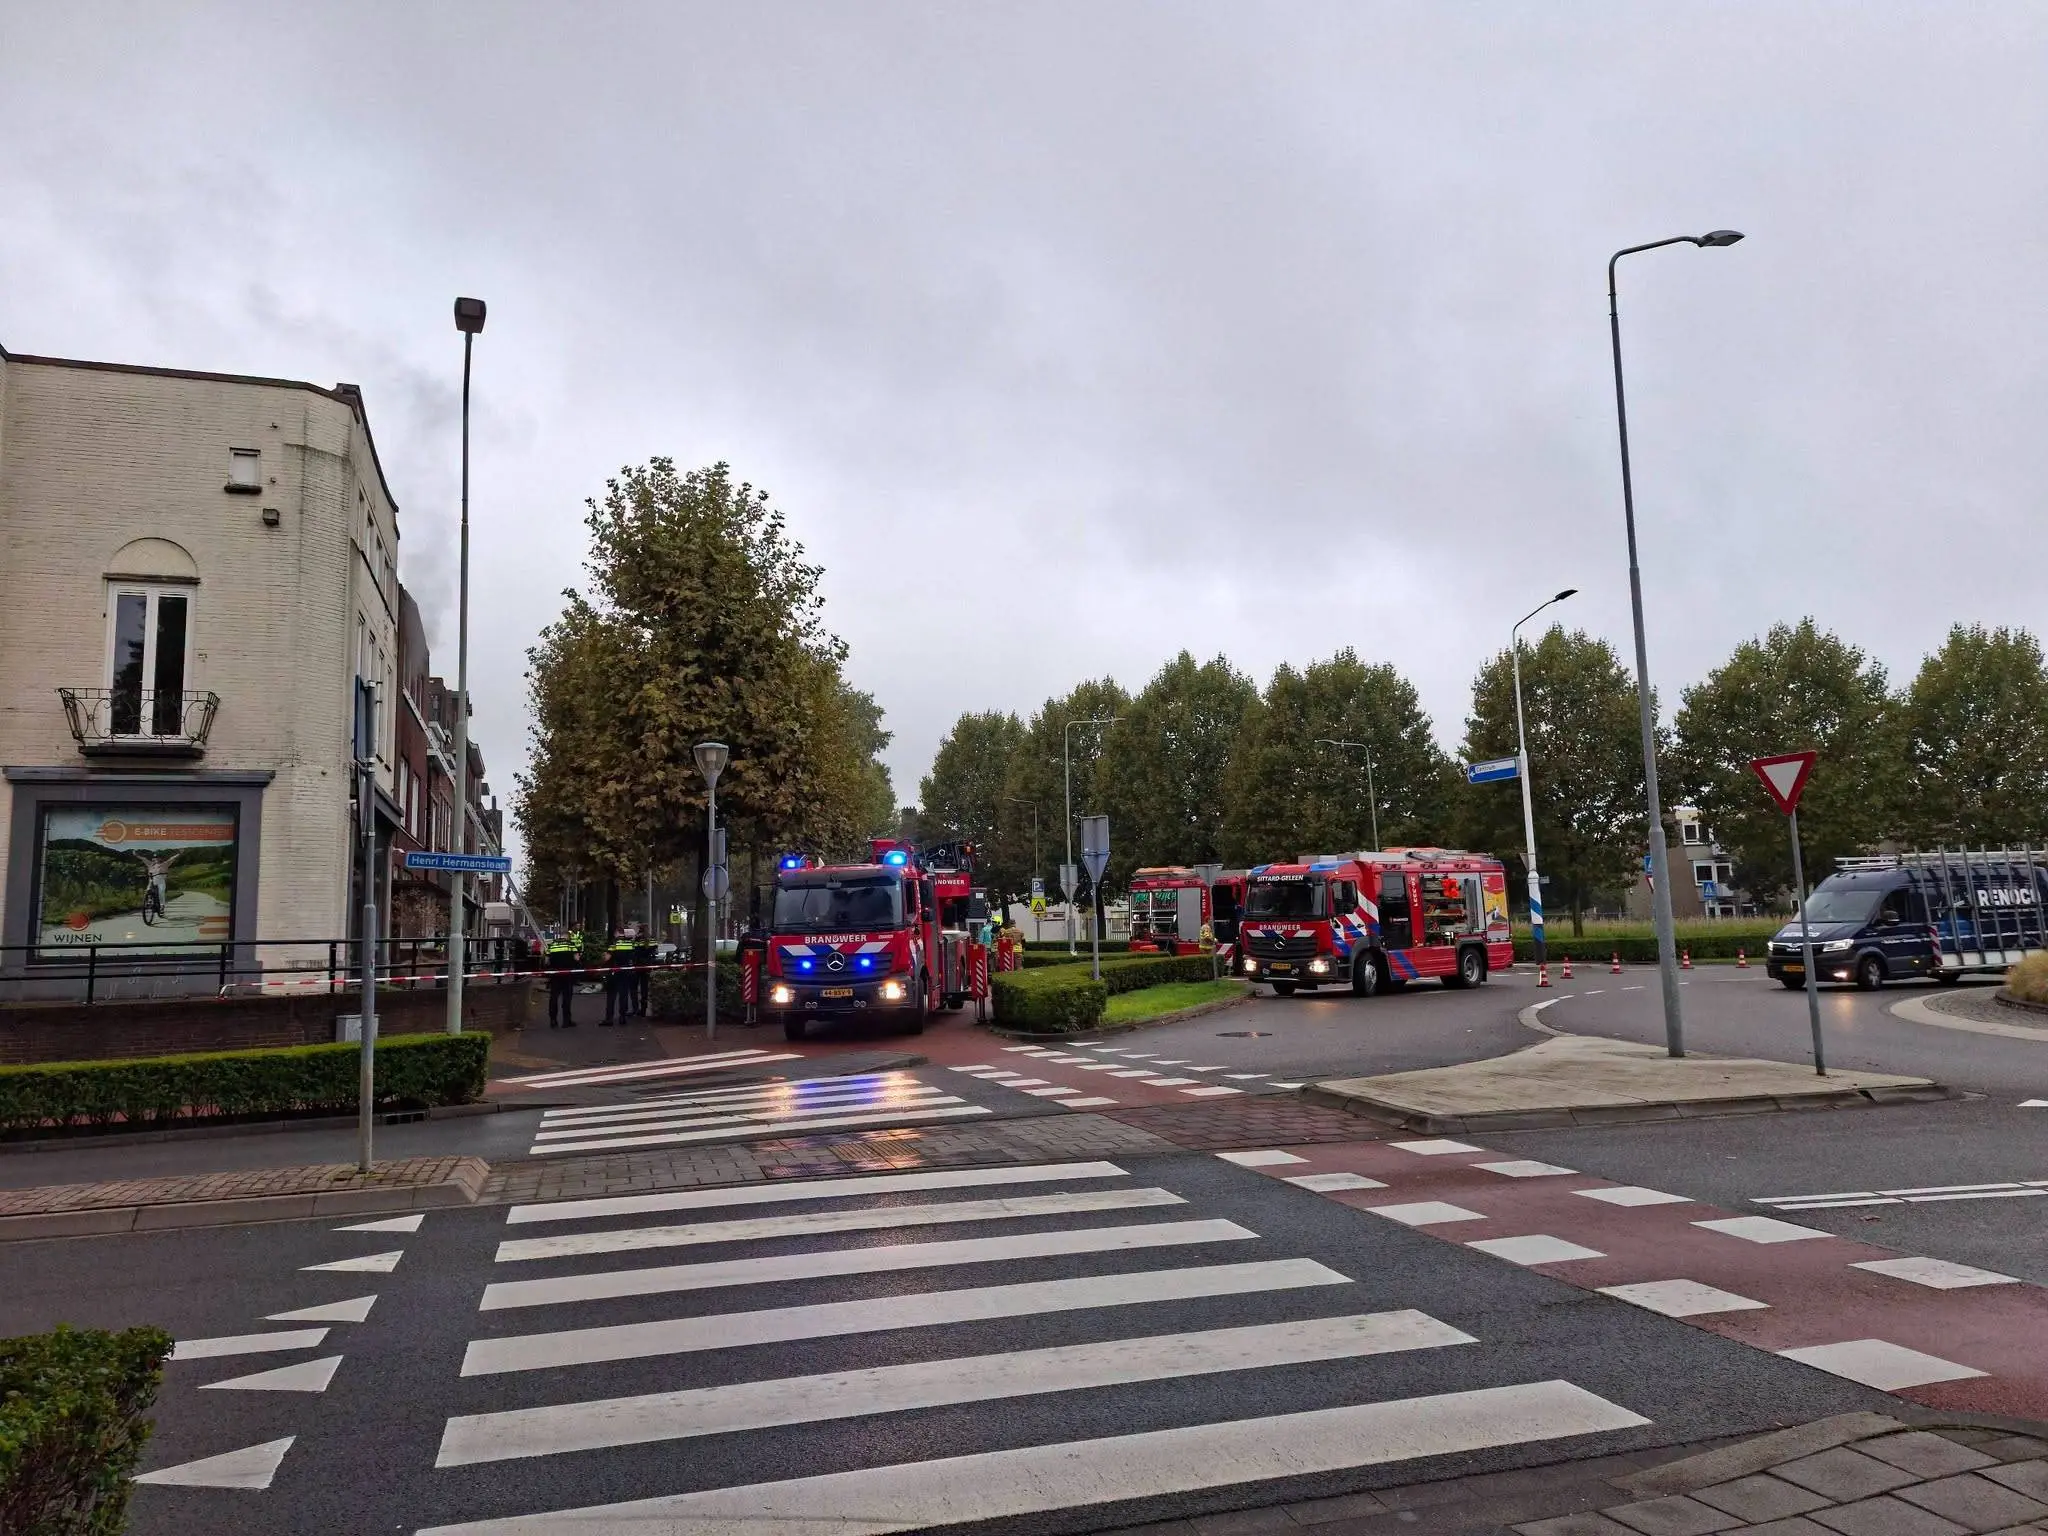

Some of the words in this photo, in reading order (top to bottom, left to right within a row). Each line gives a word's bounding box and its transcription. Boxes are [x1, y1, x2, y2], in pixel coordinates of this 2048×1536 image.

[134, 827, 167, 836] E-BIKE
[411, 857, 439, 865] Henri
[442, 858, 507, 869] Hermanslaan
[1257, 874, 1304, 882] SITTARD-GELEEN
[54, 933, 103, 944] WIJNEN
[804, 934, 867, 944] BRANDWEER
